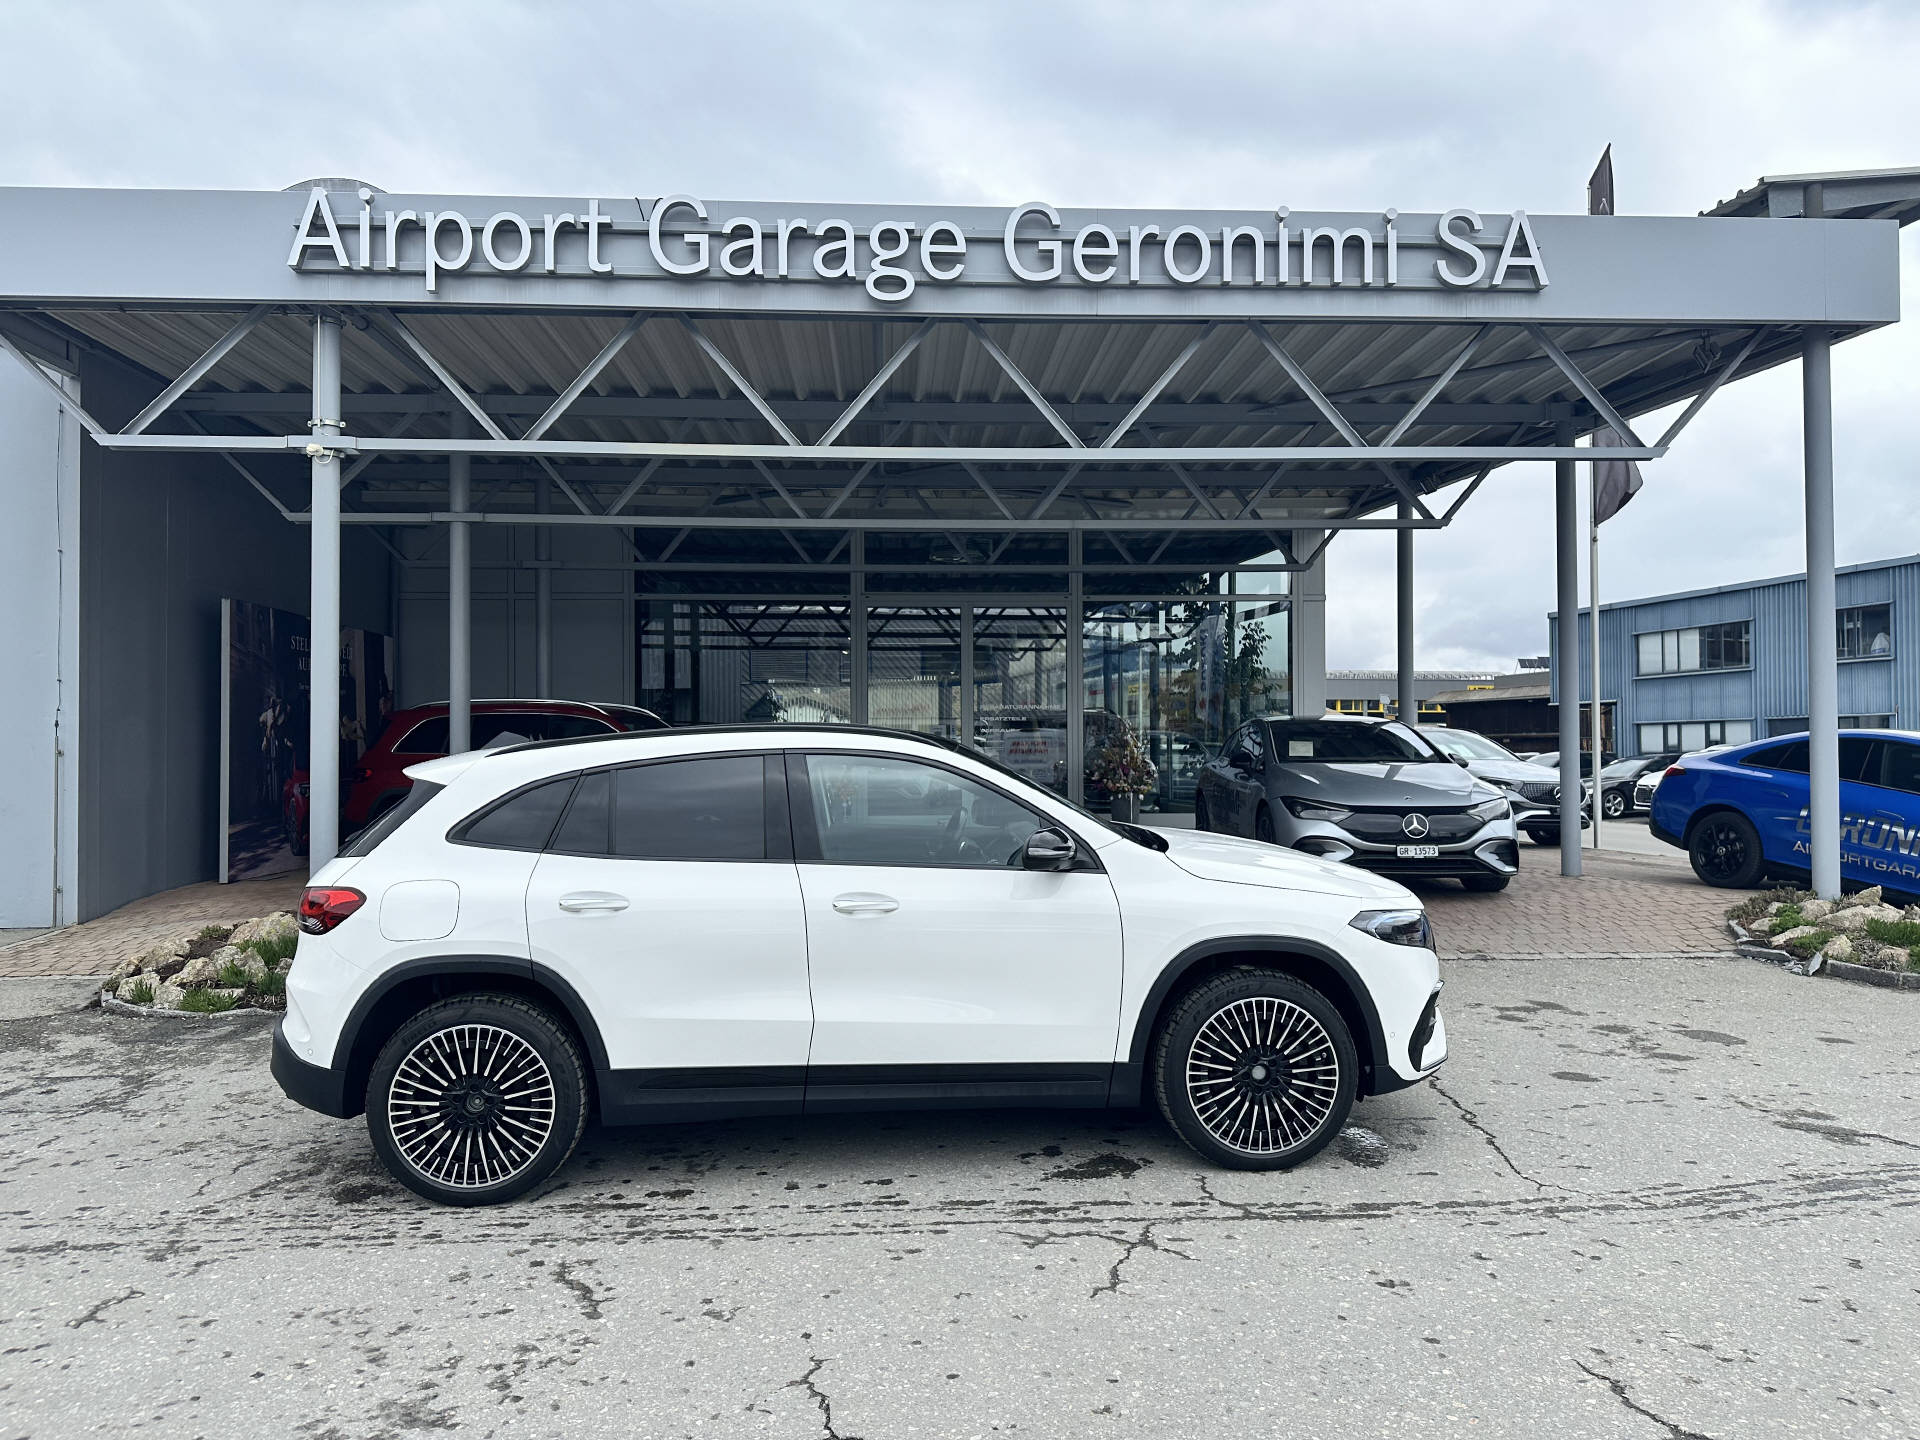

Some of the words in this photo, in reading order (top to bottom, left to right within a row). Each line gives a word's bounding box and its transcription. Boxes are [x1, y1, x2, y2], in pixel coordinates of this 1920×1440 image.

[286, 186, 613, 293] Airport
[647, 193, 967, 300] Garage
[1004, 201, 1398, 287] Geronimi
[1434, 208, 1549, 289] SA
[290, 636, 311, 652] STEL
[1399, 847, 1409, 856] GR
[1414, 846, 1436, 857] 13573
